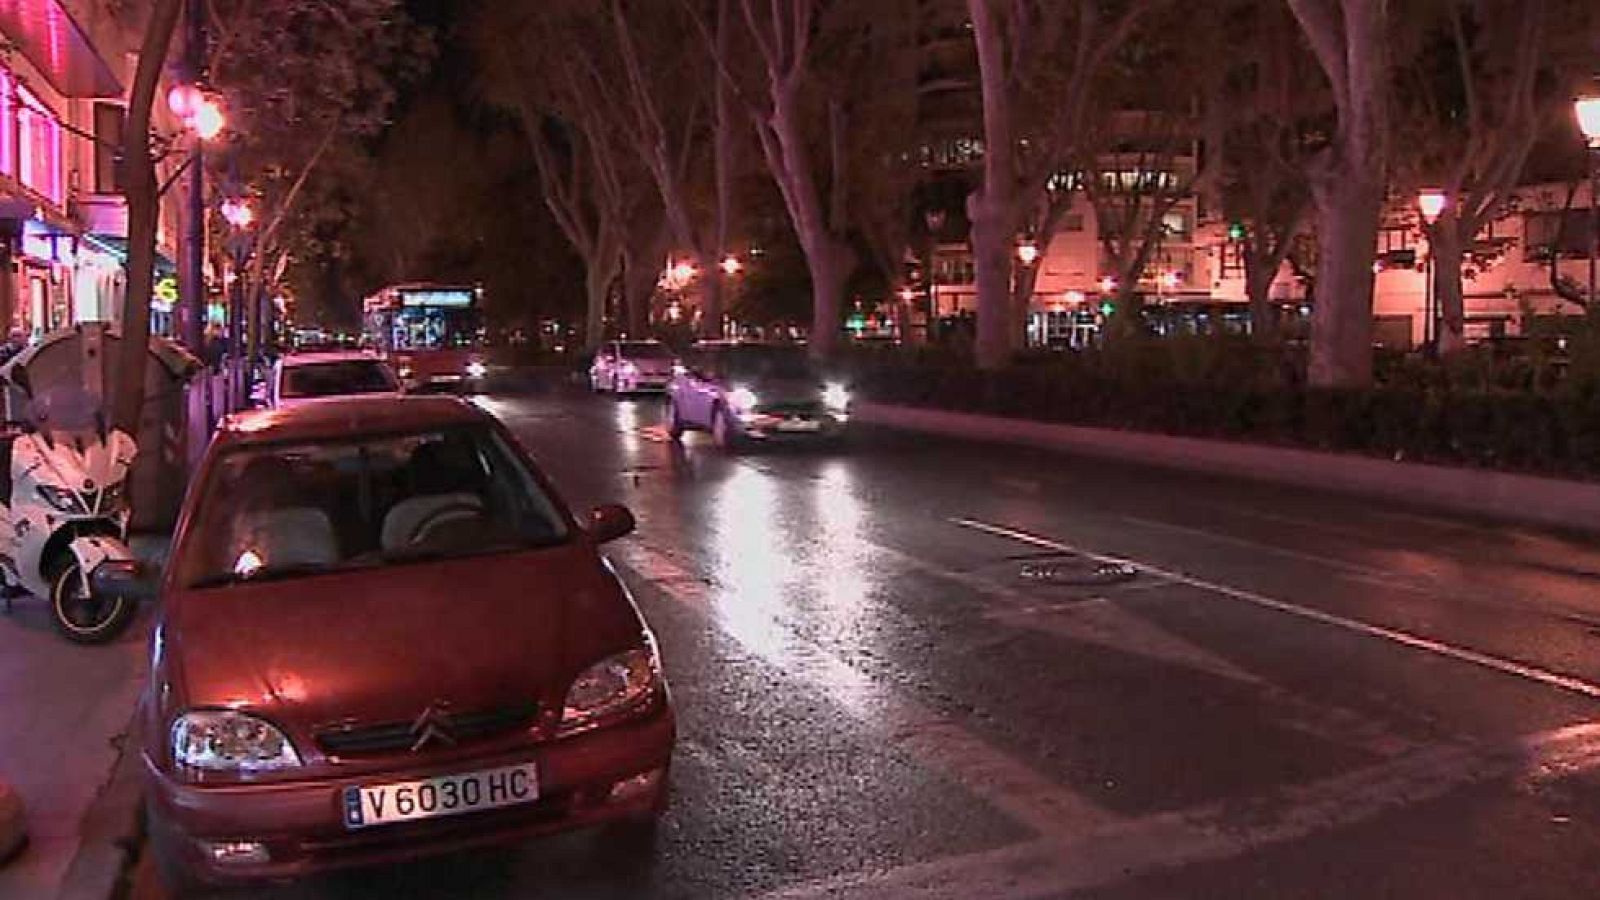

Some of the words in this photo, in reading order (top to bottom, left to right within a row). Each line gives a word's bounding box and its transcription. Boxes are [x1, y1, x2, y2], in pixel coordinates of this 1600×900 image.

[368, 790, 386, 819] V
[396, 778, 481, 815] 6030
[489, 769, 528, 802] HC
